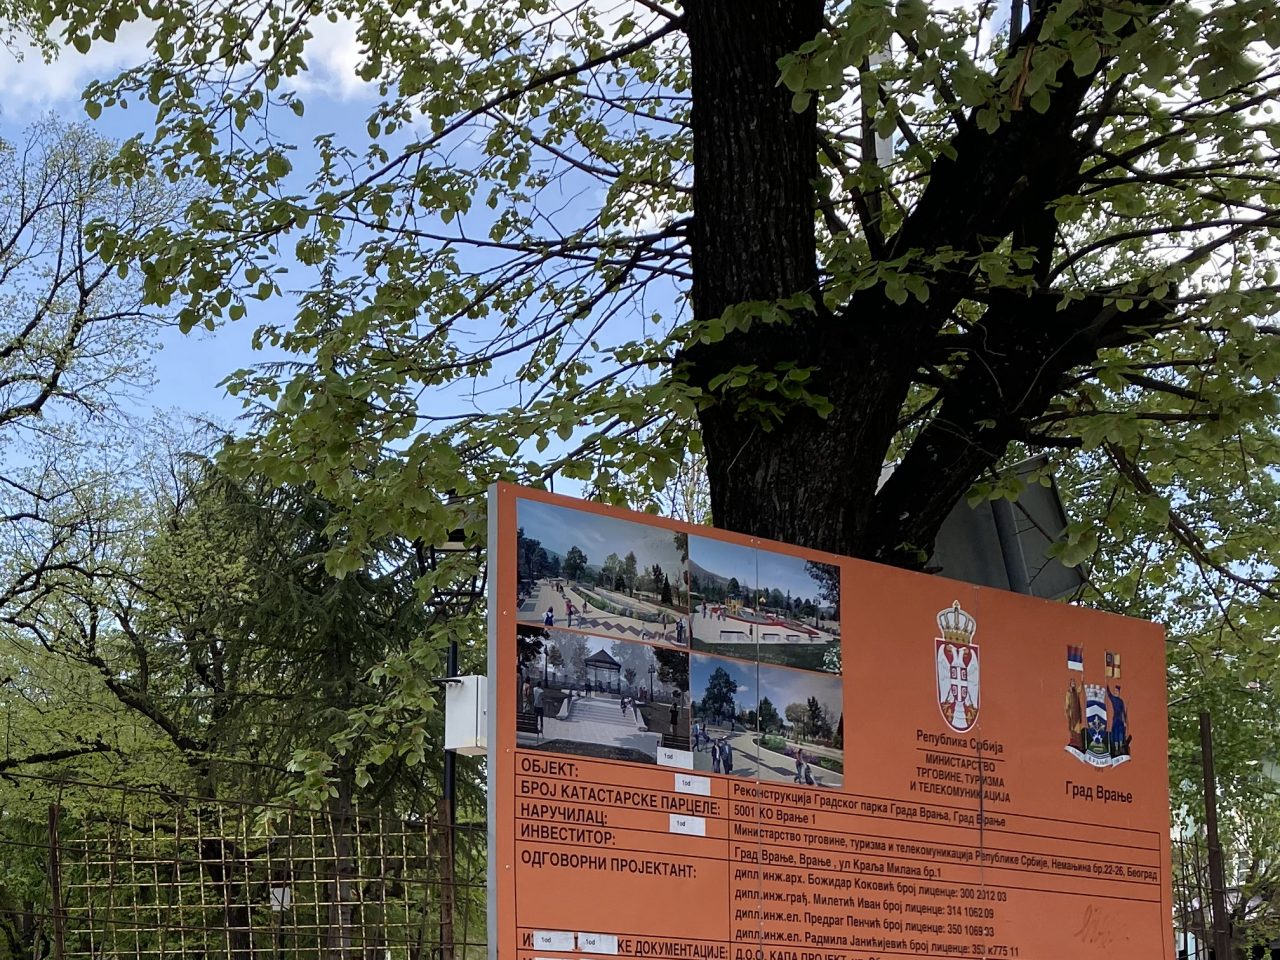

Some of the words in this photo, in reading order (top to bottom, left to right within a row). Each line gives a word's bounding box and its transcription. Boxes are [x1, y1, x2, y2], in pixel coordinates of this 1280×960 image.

[917, 729, 968, 748] Република
[970, 738, 1003, 755] Србија
[521, 758, 579, 777] ОБЈЕКТ:
[925, 753, 995, 772] МИНИСТАРСТВО
[910, 781, 916, 791] И
[919, 782, 1010, 803] ТЕЛЕКОМУНИКАЦИЈА
[965, 774, 1004, 787] ТУРИЗМА
[521, 781, 557, 797] БРОЈ
[561, 785, 657, 808] КАТАСТАРСКЕ
[661, 796, 721, 815] ПАРЦЕЛЕ:
[733, 784, 812, 806] Реконструкција
[814, 794, 858, 810] Градског
[861, 802, 888, 814] парка
[890, 803, 918, 819] Града
[919, 807, 952, 823] Врања,
[952, 810, 975, 825] Град
[1066, 781, 1093, 801] Град
[1096, 784, 1133, 805] Врање
[521, 803, 608, 826] НАРУЧИЛАЦ:
[733, 805, 755, 818] 5001
[759, 808, 774, 820] КО
[776, 810, 809, 824] Врање
[811, 814, 816, 825] 1
[521, 824, 616, 845] ИНВЕСТИТОР:
[521, 850, 606, 870] ОДГОВОРНИ
[611, 857, 697, 878] ПРОЈЕКТАНТ:
[734, 824, 801, 842] Министарство
[803, 834, 848, 849] трговине,
[850, 839, 886, 851] туризма
[896, 844, 973, 863] телекомуникација
[1127, 866, 1158, 882] Београд
[734, 847, 758, 862] Град
[839, 860, 851, 870] ул
[853, 859, 885, 872] Краља
[887, 863, 921, 875] Милана
[807, 874, 852, 890] Божидар
[854, 879, 895, 892] Коковић
[897, 882, 916, 897] број
[960, 888, 975, 899] 300
[813, 894, 855, 908] Милетић
[857, 899, 880, 910] Иван
[883, 900, 902, 914] број
[946, 905, 962, 917] 314
[804, 913, 844, 928] Предраг
[847, 916, 881, 929] Пенчић
[883, 919, 903, 933] број
[947, 924, 962, 935] 350
[635, 940, 728, 960] ДОКУМЕНТАЦИЈЕ:
[804, 932, 847, 946] Радмила
[910, 940, 929, 953] број
